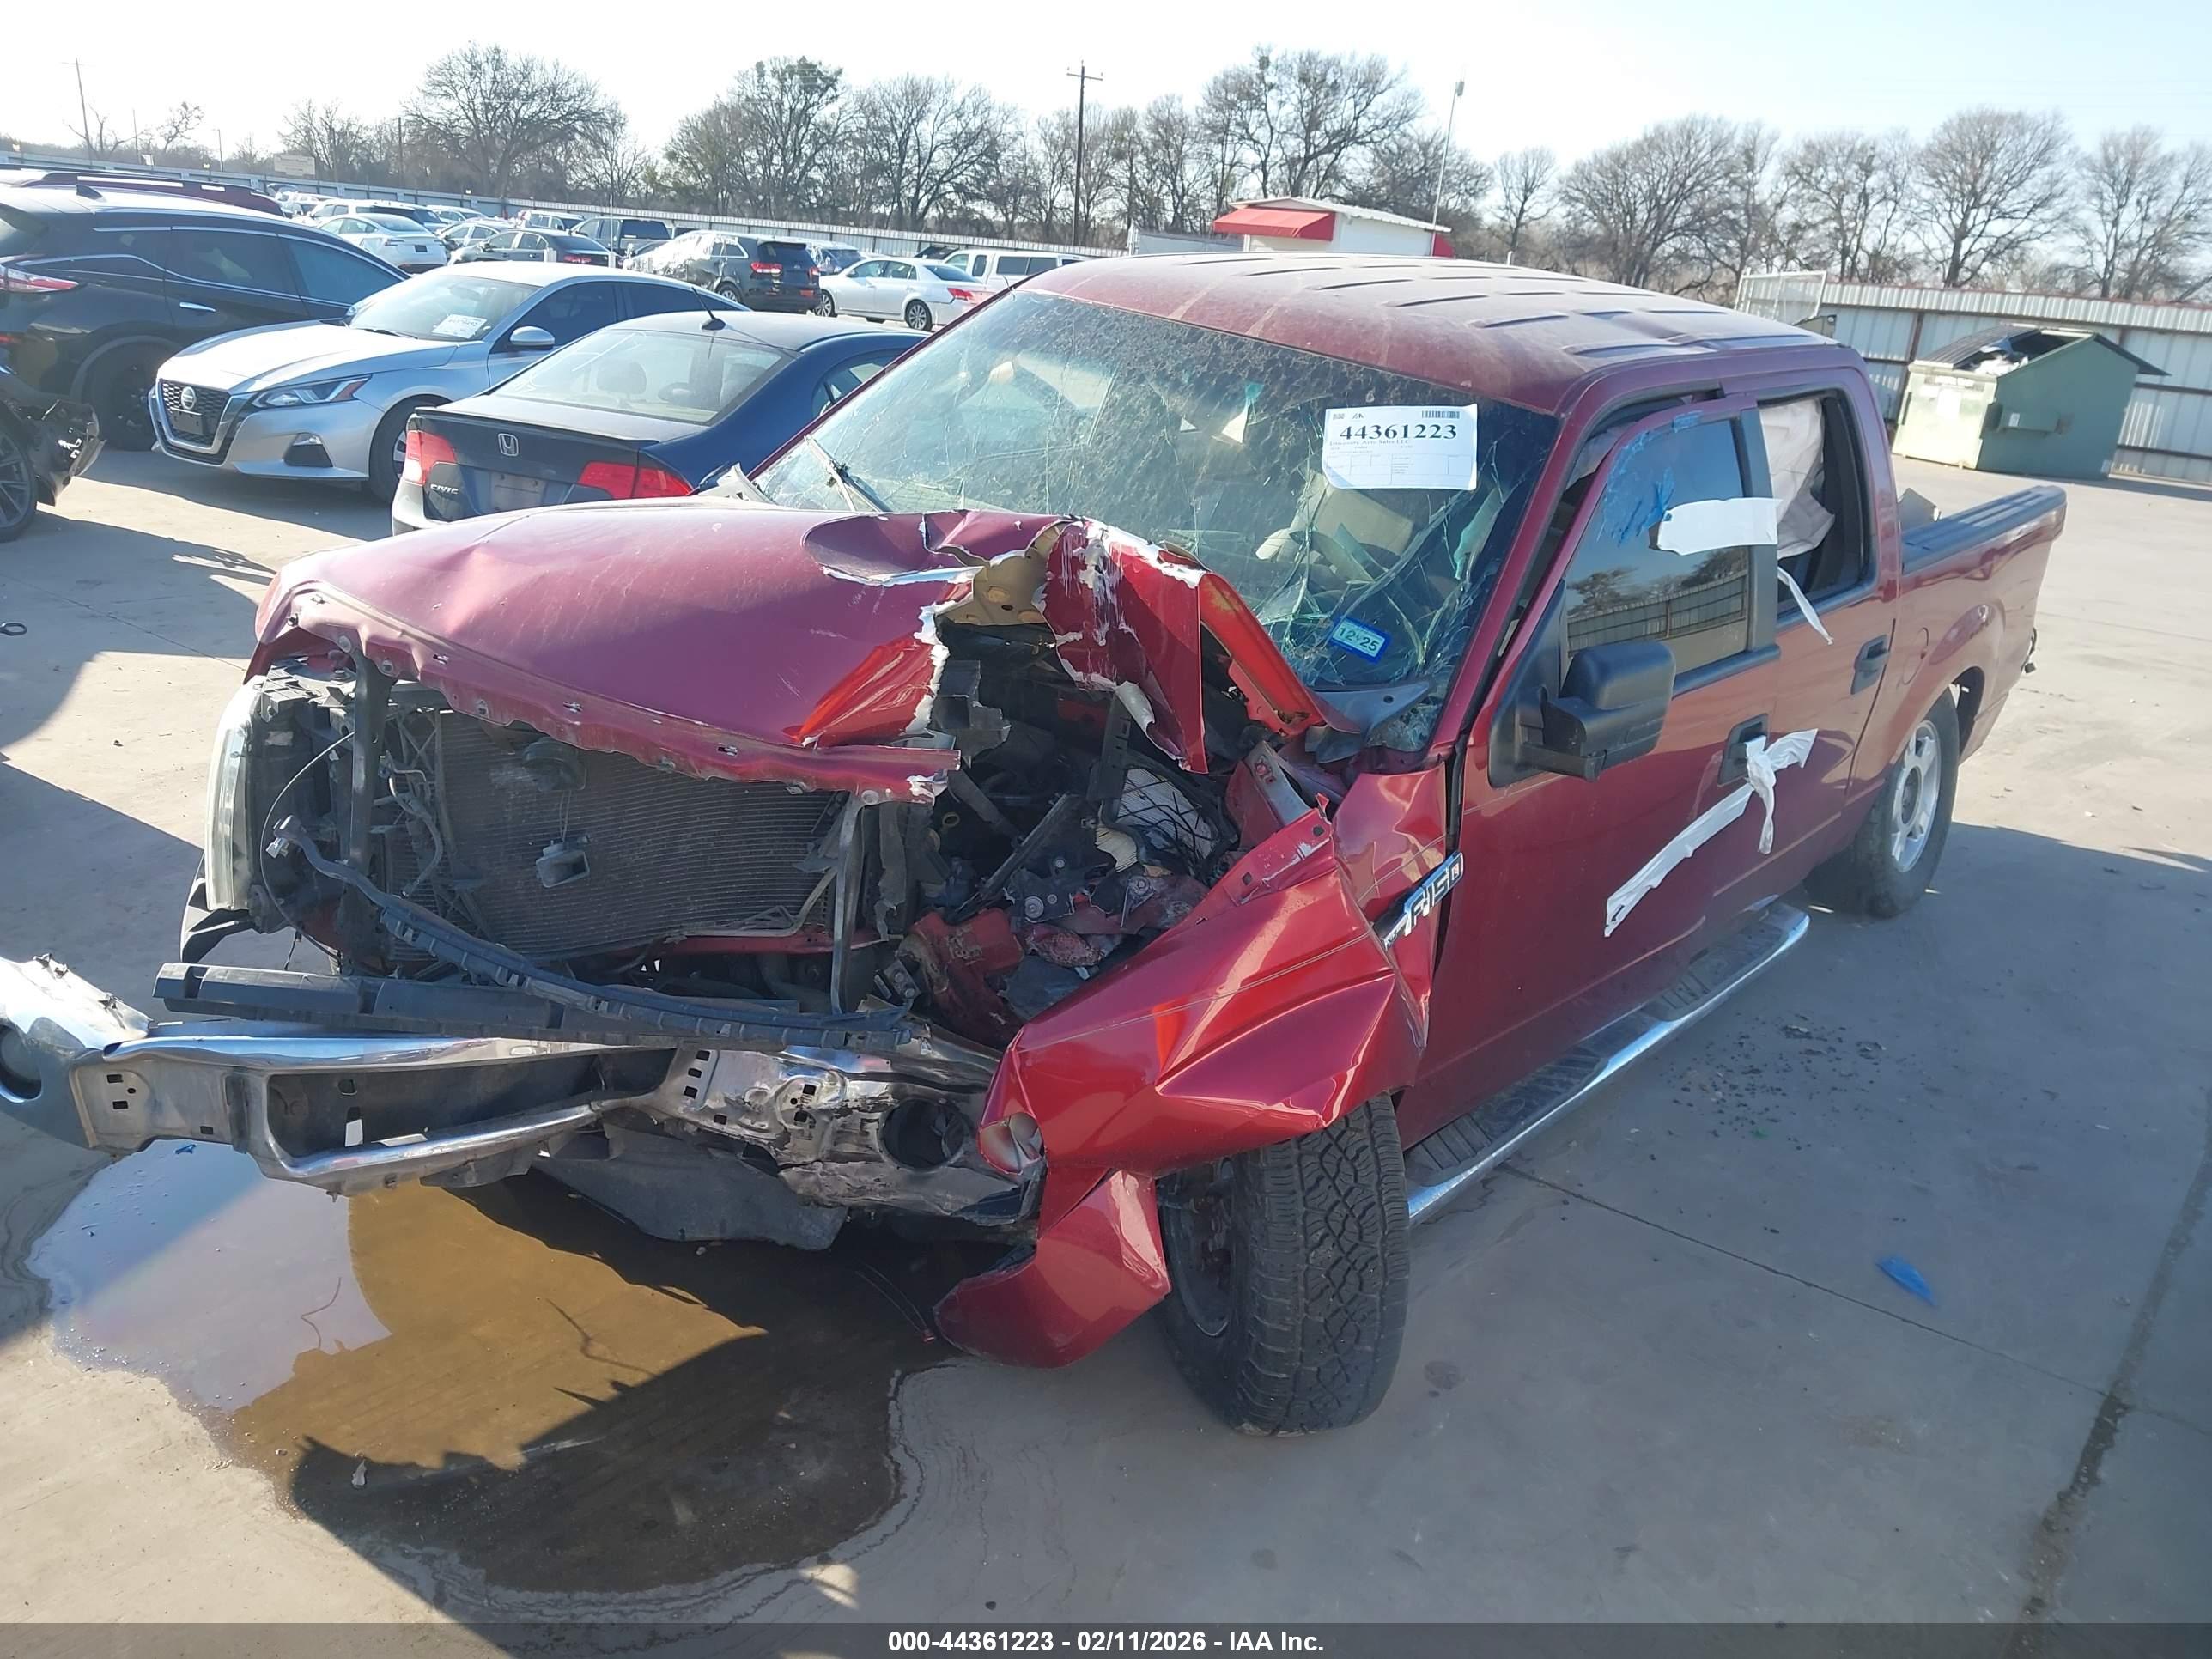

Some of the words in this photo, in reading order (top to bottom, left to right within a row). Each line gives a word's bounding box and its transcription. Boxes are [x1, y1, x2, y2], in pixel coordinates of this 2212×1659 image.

[1340, 424, 1457, 440] 44361223
[430, 483, 459, 495] CIVIC
[1359, 636, 1380, 652] 25
